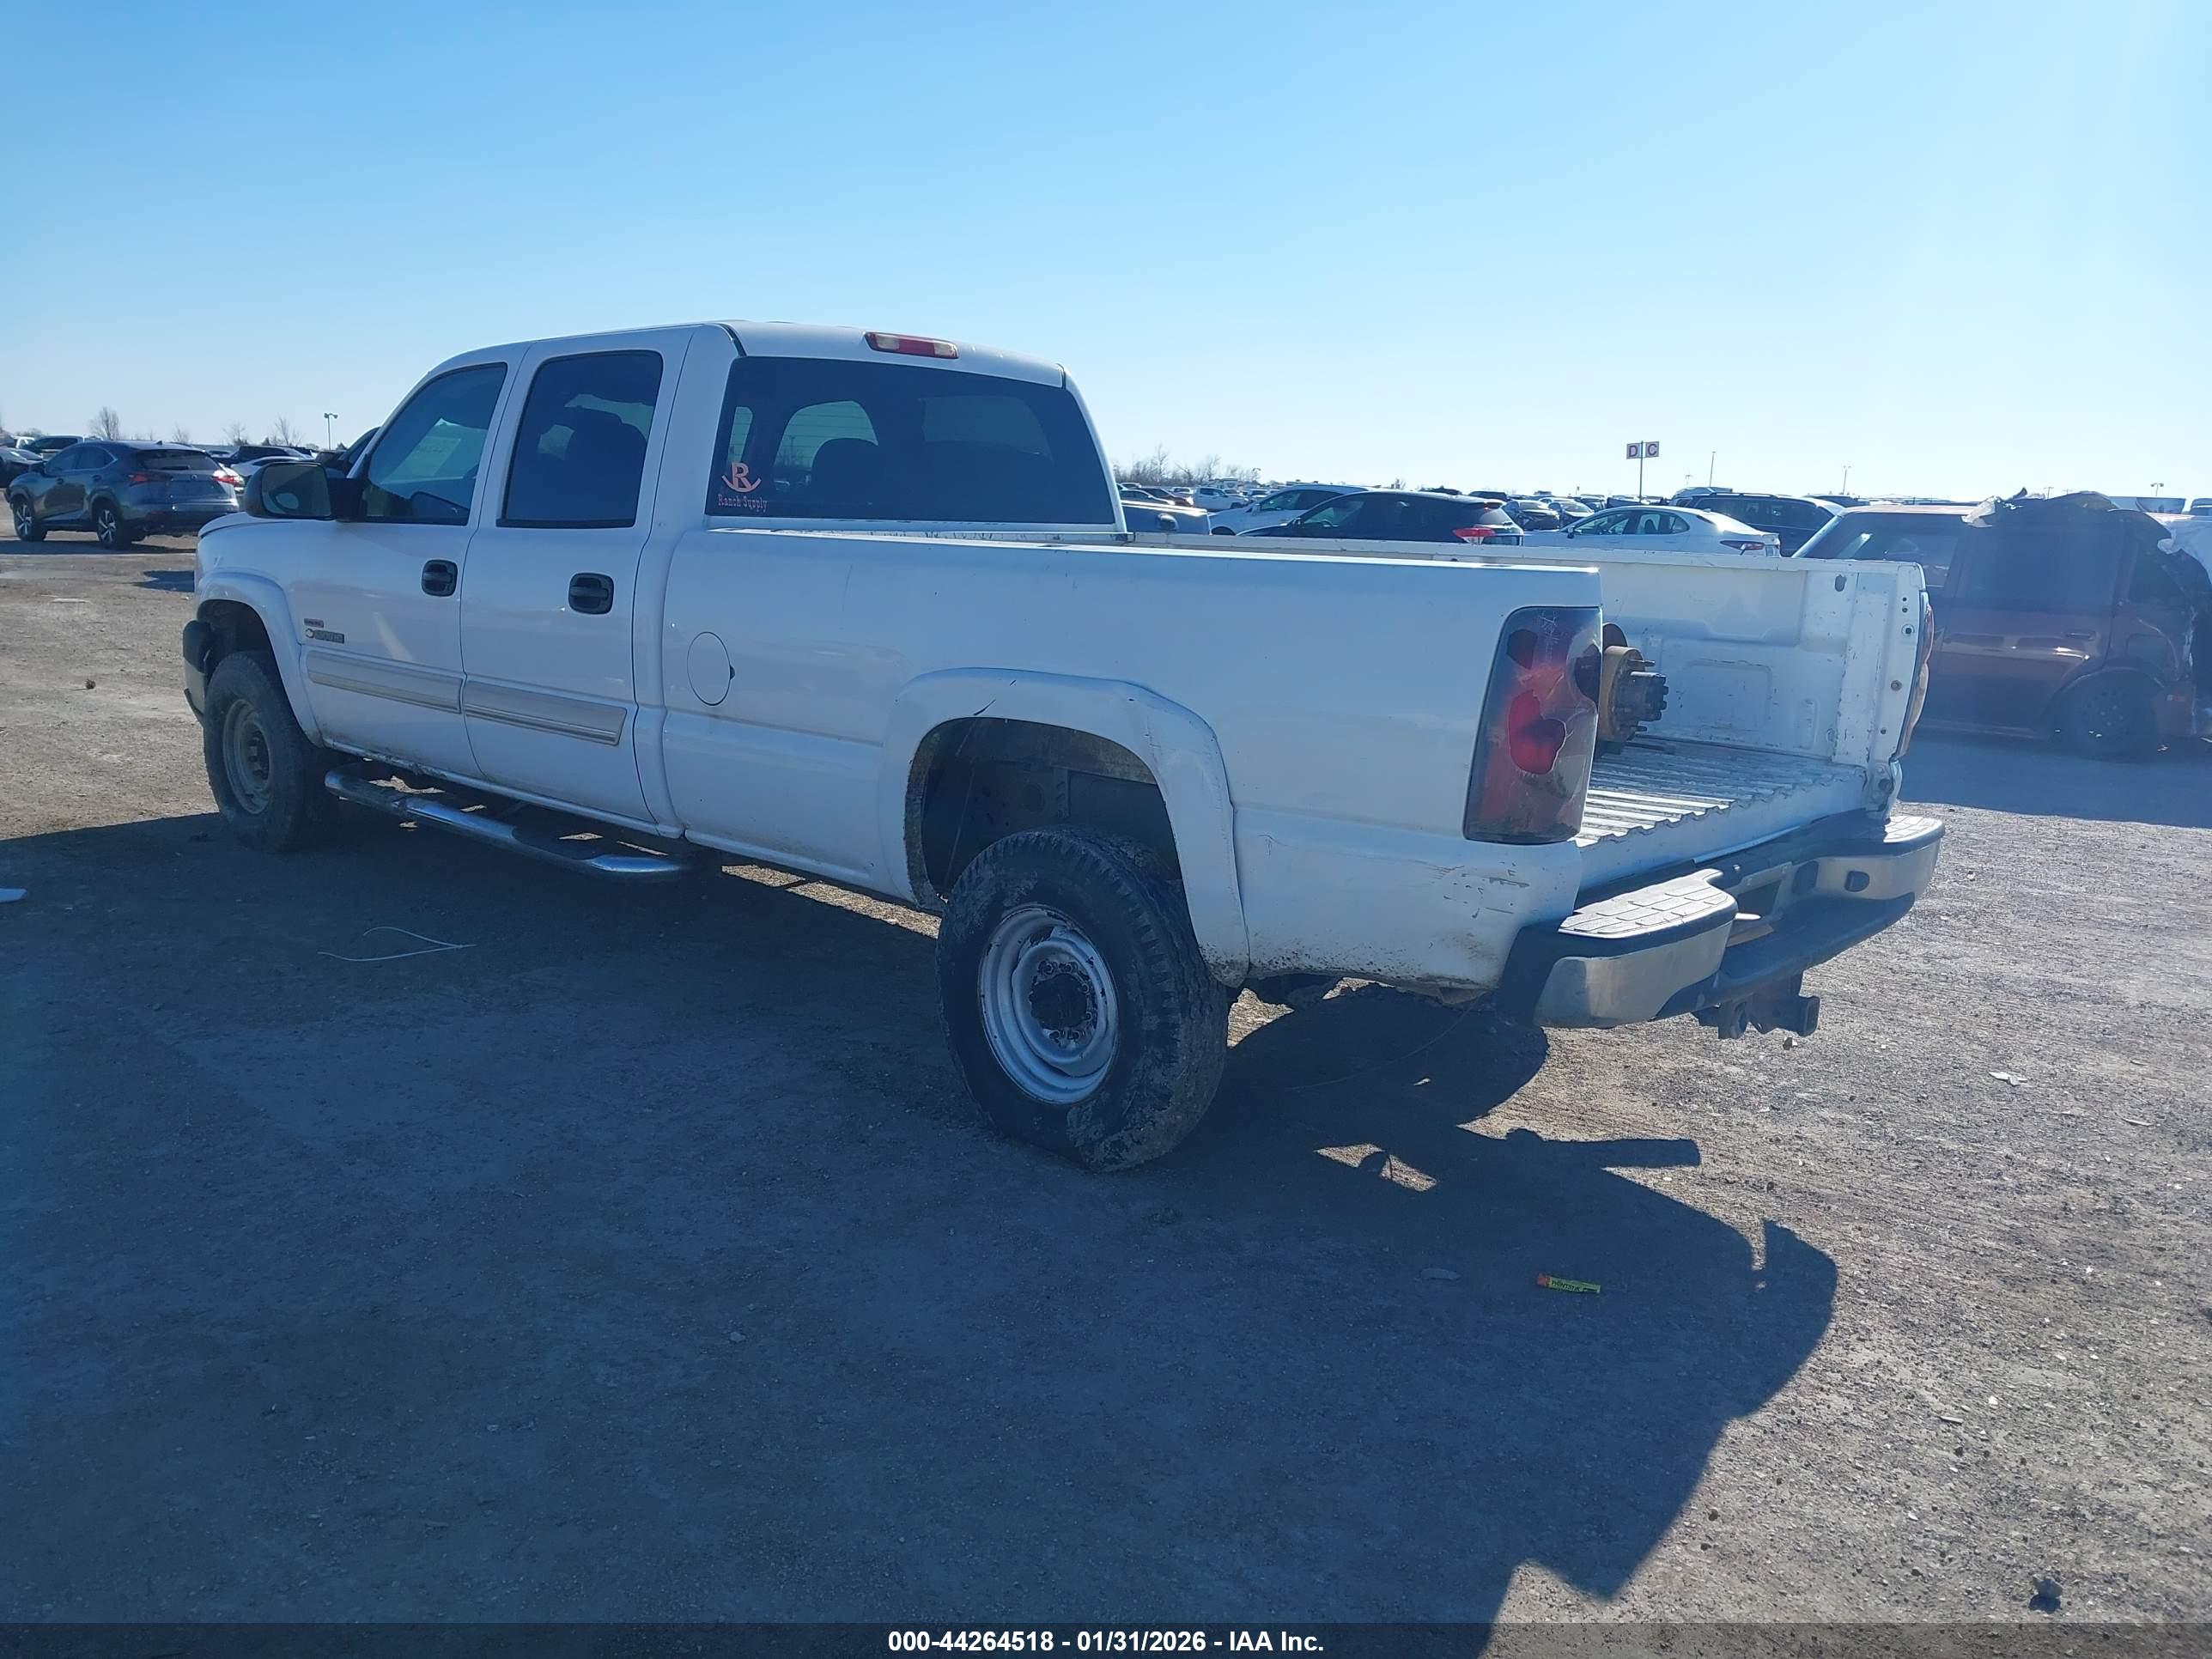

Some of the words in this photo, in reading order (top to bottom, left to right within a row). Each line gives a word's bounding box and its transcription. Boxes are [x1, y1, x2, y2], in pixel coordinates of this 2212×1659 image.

[1628, 445, 1638, 457] D
[1647, 443, 1657, 456] C
[732, 462, 752, 490] R
[717, 494, 741, 507] Ranch
[743, 495, 768, 513] Supply
